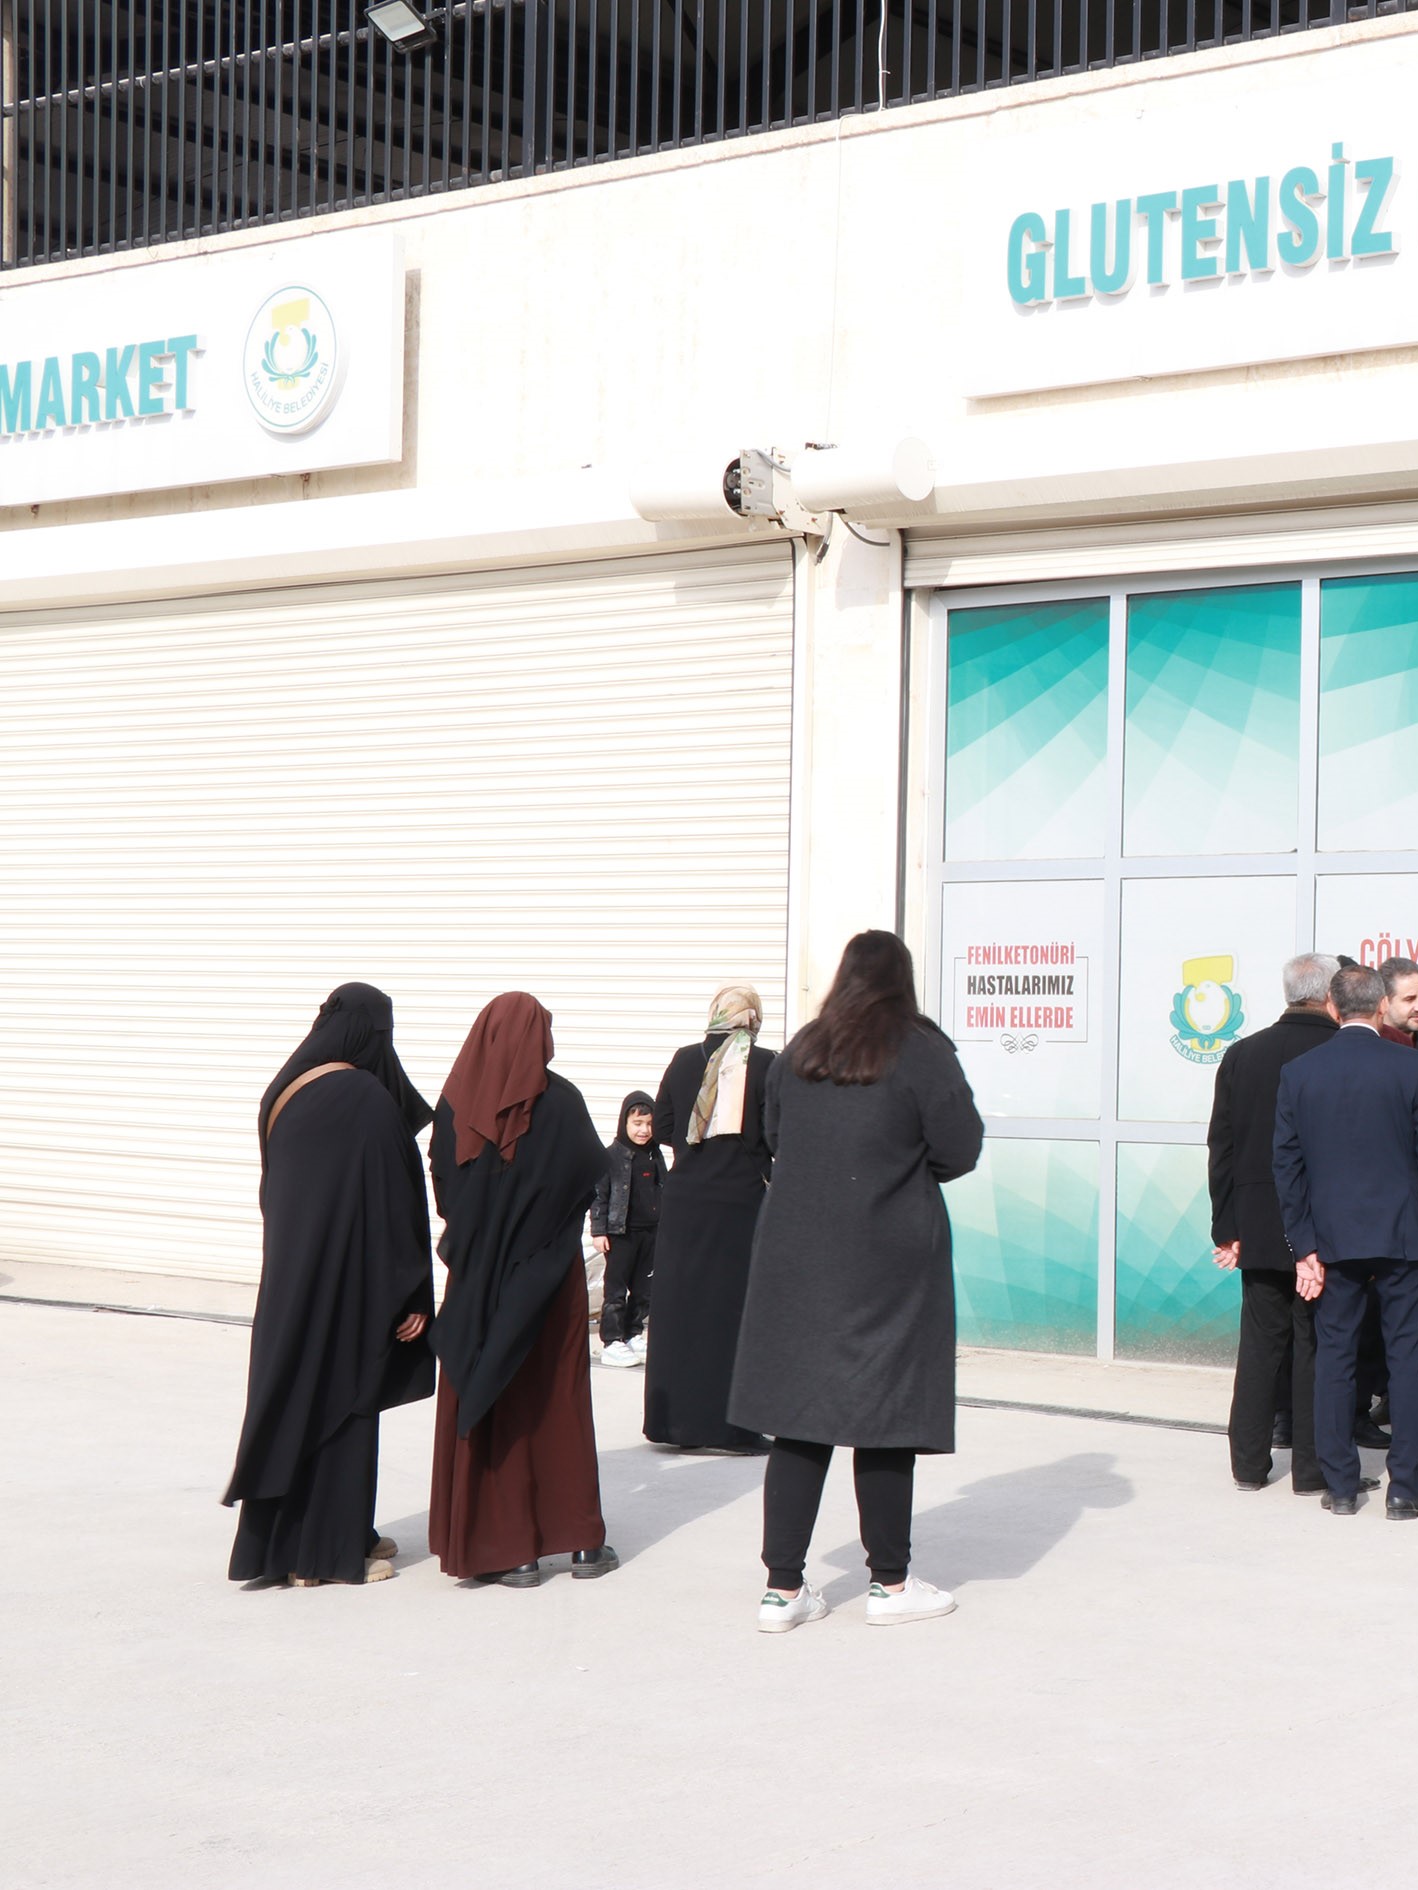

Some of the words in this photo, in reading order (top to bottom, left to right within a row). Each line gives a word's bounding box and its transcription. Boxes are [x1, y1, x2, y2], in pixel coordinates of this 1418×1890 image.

[1007, 141, 1394, 305] GLUTENSİZ
[0, 334, 197, 434] MARKET
[967, 942, 1075, 965] FENİLKETONÜRİ
[967, 975, 1074, 995] HASTALARIMIZ
[966, 1002, 1005, 1028] EMİN
[1010, 1006, 1073, 1028] ELLERDE
